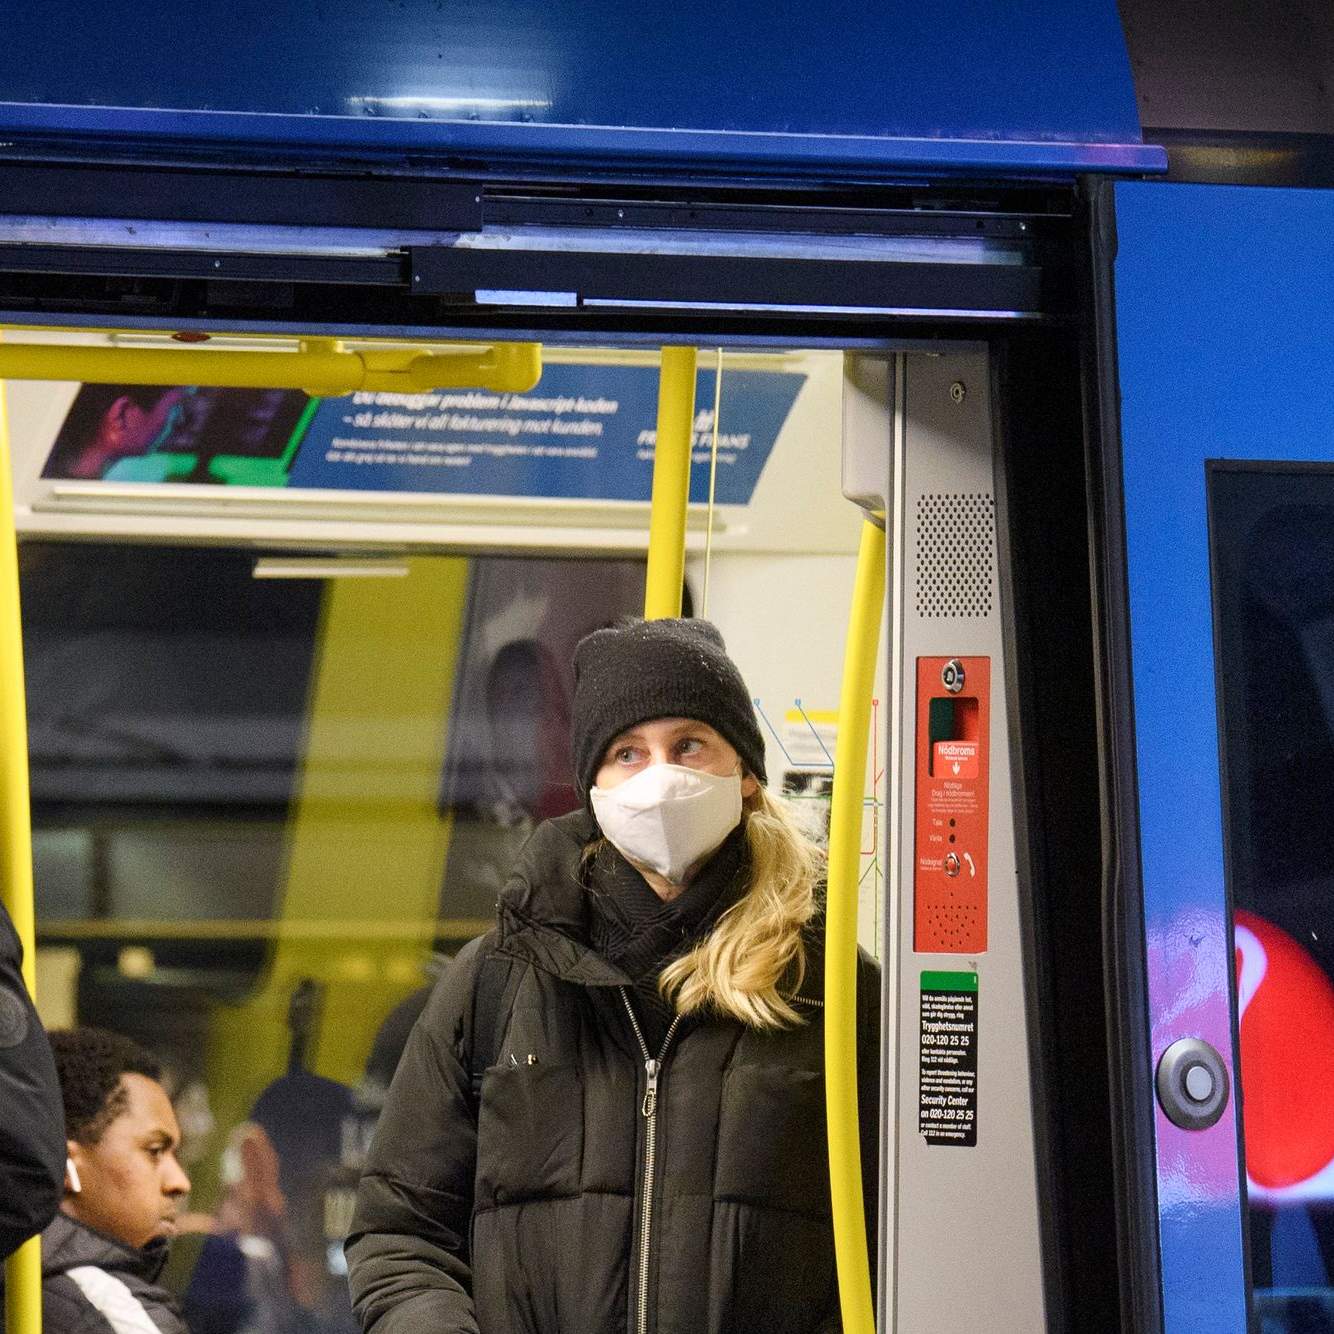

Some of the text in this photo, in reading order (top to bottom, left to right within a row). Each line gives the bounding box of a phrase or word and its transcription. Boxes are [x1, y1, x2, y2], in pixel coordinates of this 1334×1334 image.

[938, 745, 975, 756] Nödbroms
[922, 1020, 974, 1032] Trygghetsnumret
[921, 1034, 970, 1046] 020-120 25 25
[921, 1094, 969, 1107] Security Center
[921, 1108, 974, 1120] on 020-120 25 25
